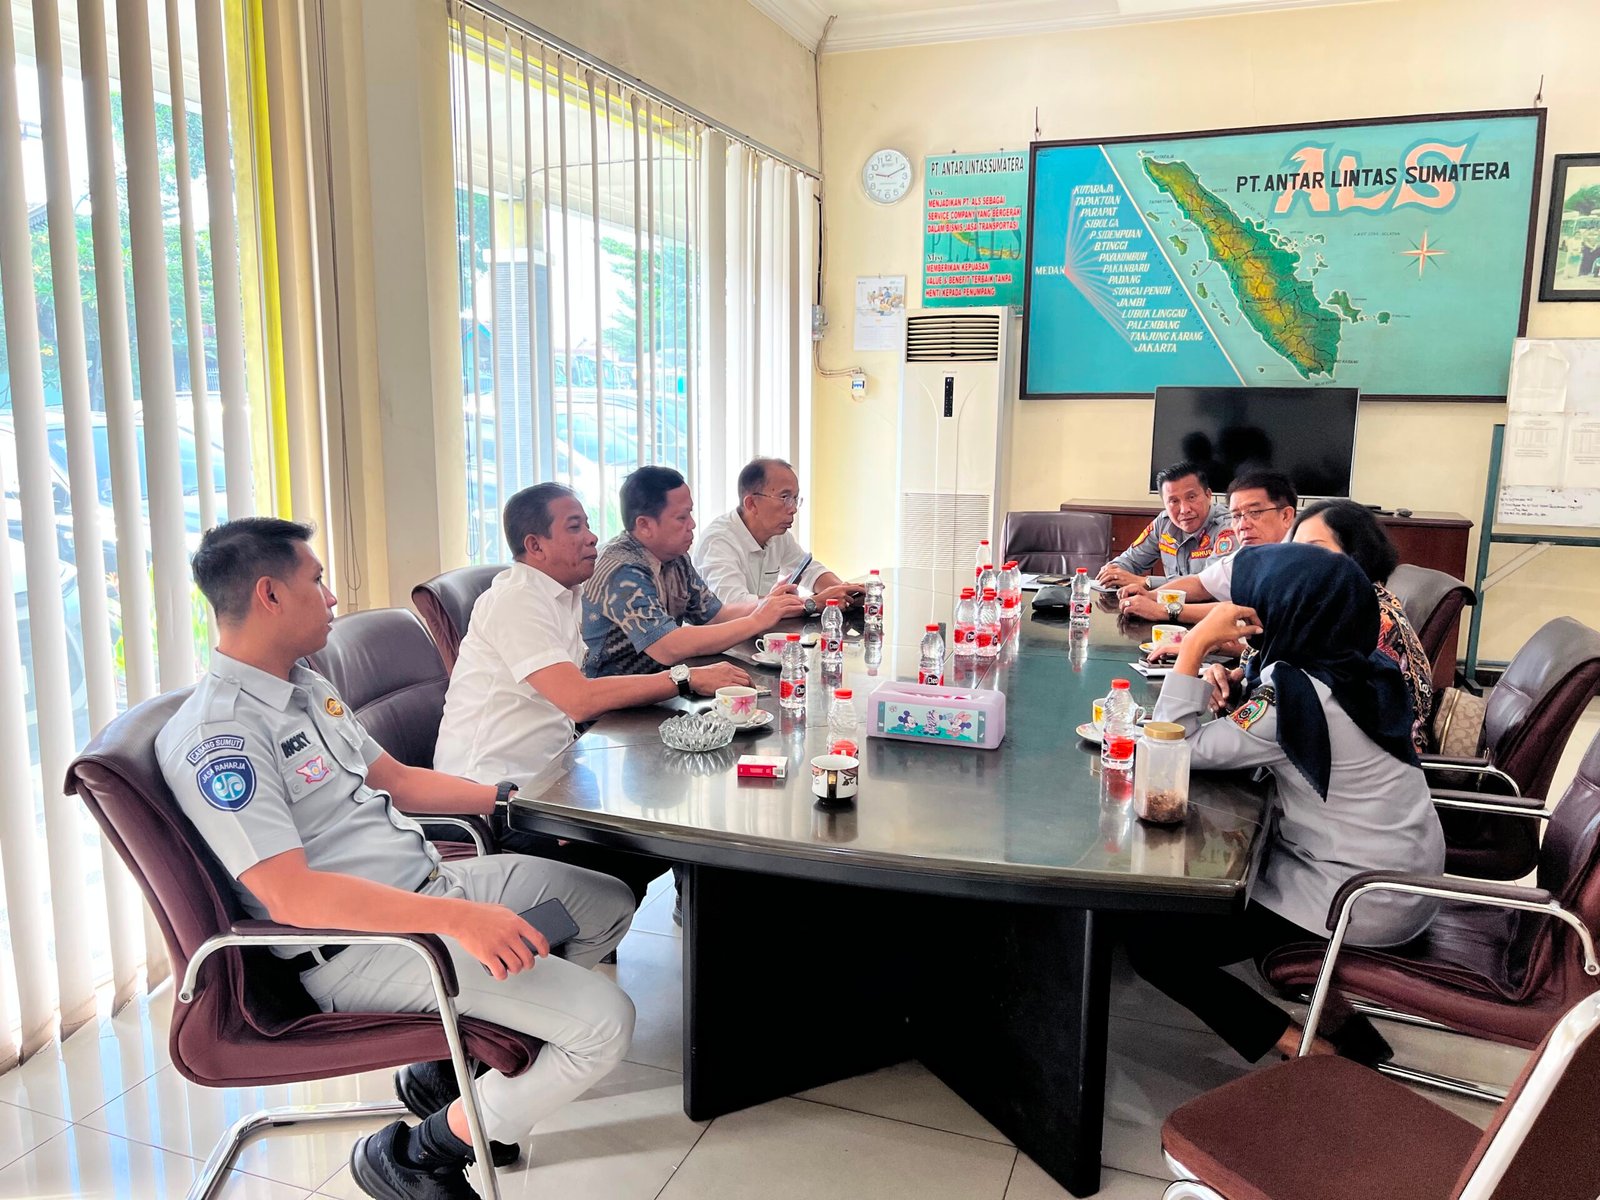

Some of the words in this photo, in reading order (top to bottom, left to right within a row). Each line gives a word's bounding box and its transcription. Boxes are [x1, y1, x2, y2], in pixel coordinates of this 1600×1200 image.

[942, 160, 963, 175] ANTAR
[965, 159, 987, 174] LINTAS
[988, 157, 1024, 173] SUMATERA
[1236, 175, 1261, 193] PT.
[1264, 171, 1325, 192] ANTAR
[1330, 167, 1398, 188] LINTAS
[1404, 161, 1510, 184] SUMATERA
[1073, 184, 1114, 195] KUTARAJA
[928, 199, 961, 208] MENJADIKAN
[971, 197, 981, 206] ALS
[982, 196, 1005, 205] SEBAGAI
[1075, 195, 1121, 206] TAPAKTUAN
[928, 212, 949, 220] SERVICE
[950, 210, 975, 219] COMPANY
[976, 209, 991, 218] YANG
[991, 208, 1021, 217] BERGERAK
[1080, 207, 1118, 217] PARAPAT
[927, 225, 945, 233] DALAM
[945, 224, 963, 233] BISNIS
[963, 223, 977, 231] JASA
[979, 221, 1018, 231] TRANSPORTASI
[1084, 218, 1119, 228] SIBOLGA
[1098, 251, 1148, 262] PAYAKUMBUH
[926, 264, 960, 272] MEMBERIKAN
[961, 262, 990, 271] KEPUASAN
[1102, 263, 1150, 274] PAKANBARU
[926, 276, 942, 285] VALUE
[948, 275, 970, 284] BENEFIT
[971, 274, 994, 284] TERBAIK
[995, 273, 1012, 283] TANPA
[1108, 275, 1141, 285] PADANG
[942, 288, 962, 297] KEPADA
[963, 287, 996, 296] PENUMPANG
[1112, 286, 1142, 296] SUNGAI
[1143, 286, 1172, 295] PENUH
[1116, 297, 1146, 307] JAMBI
[1121, 309, 1151, 319] LUBUK
[1151, 308, 1187, 318] LINGGAU
[1126, 320, 1180, 330] PALEMBANG
[1130, 331, 1170, 342] TANJUNG
[1170, 331, 1203, 341] KARANG
[1134, 343, 1177, 353] JAKARTA
[191, 741, 215, 760] CABANG
[215, 739, 241, 748] SUMUT
[202, 768, 215, 784] JASA
[214, 761, 246, 772] RAHARJA
